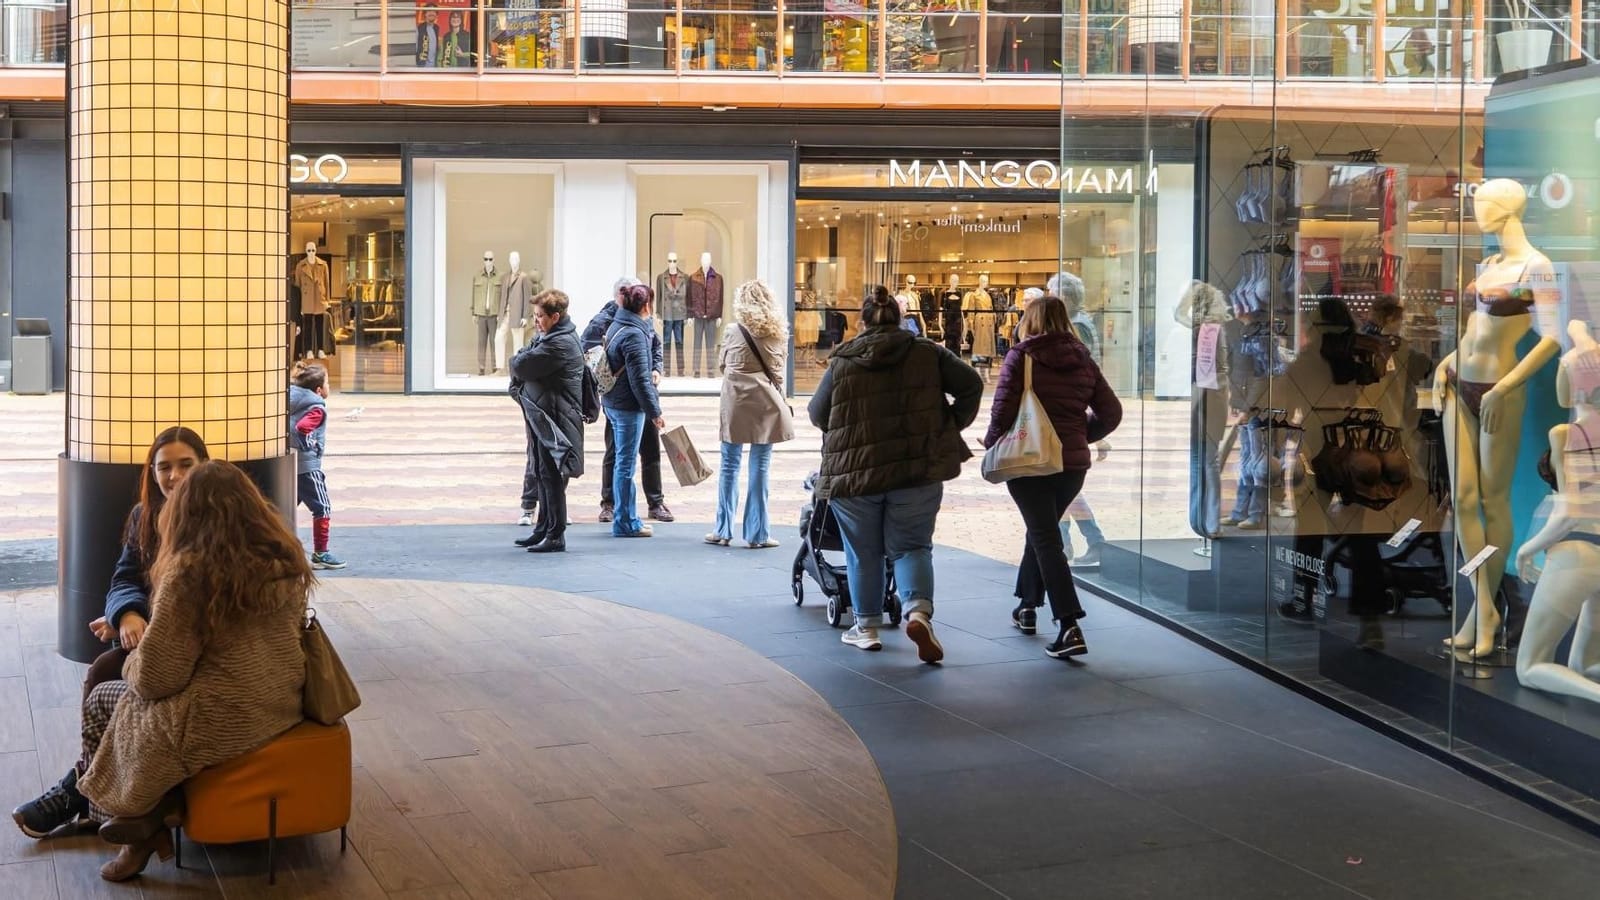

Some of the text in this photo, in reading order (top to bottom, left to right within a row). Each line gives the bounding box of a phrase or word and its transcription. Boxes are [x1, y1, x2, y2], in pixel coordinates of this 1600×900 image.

[889, 159, 1057, 188] MANGO
[1285, 549, 1305, 569] NEVER
[1305, 555, 1326, 576] CLOSE
